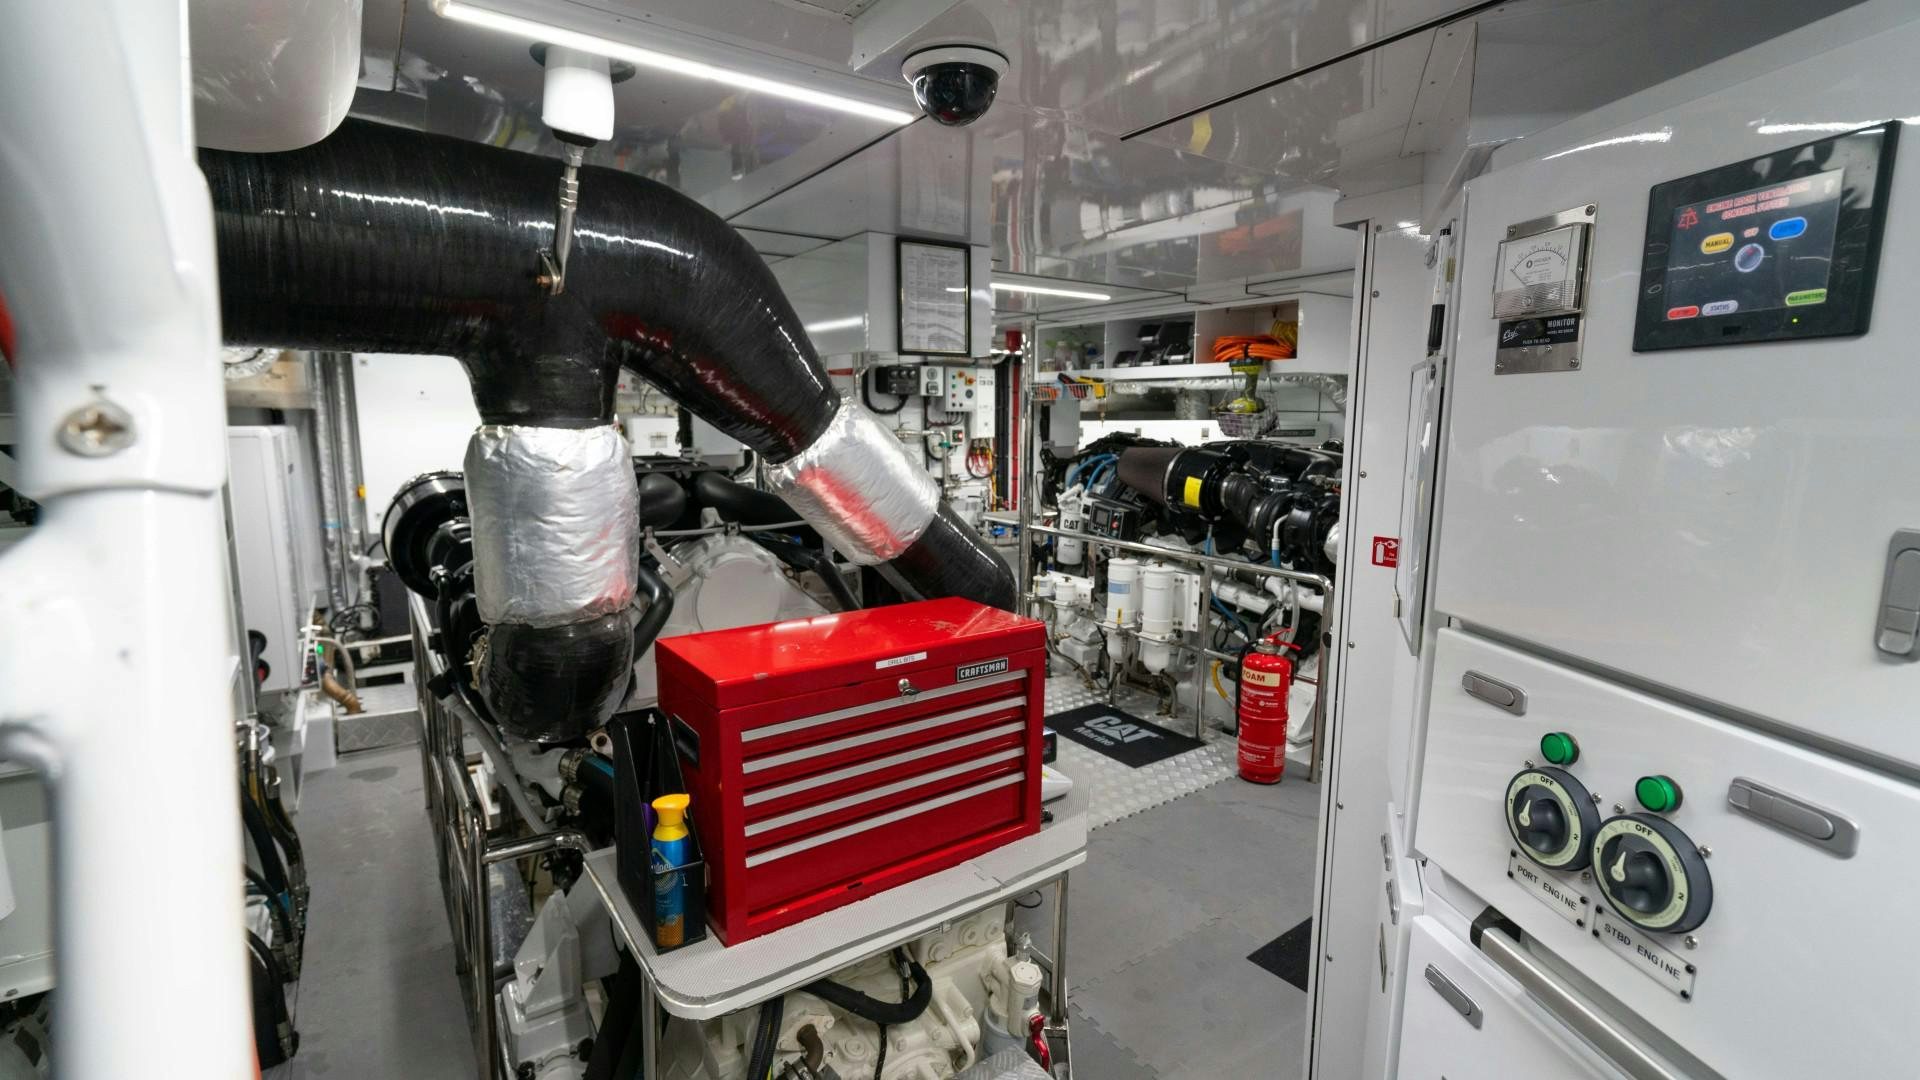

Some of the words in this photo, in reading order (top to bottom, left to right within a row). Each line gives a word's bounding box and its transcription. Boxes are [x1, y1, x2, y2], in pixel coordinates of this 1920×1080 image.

[1705, 239, 1731, 249] MANUAL
[1547, 318, 1575, 328] MONITOR
[1063, 519, 1080, 530] CAT
[959, 660, 1006, 679] CRAFTSMAN
[1243, 669, 1266, 683] FOAM
[1083, 715, 1160, 744] CAT
[1540, 775, 1554, 787] OFF
[1635, 823, 1653, 837] OFF
[1573, 833, 1580, 841] 2
[1517, 864, 1539, 885] PORT
[1542, 882, 1578, 911] ENGINE
[1677, 891, 1685, 901] 2
[1603, 923, 1632, 947] STBD
[1637, 944, 1681, 981] ENGINE
